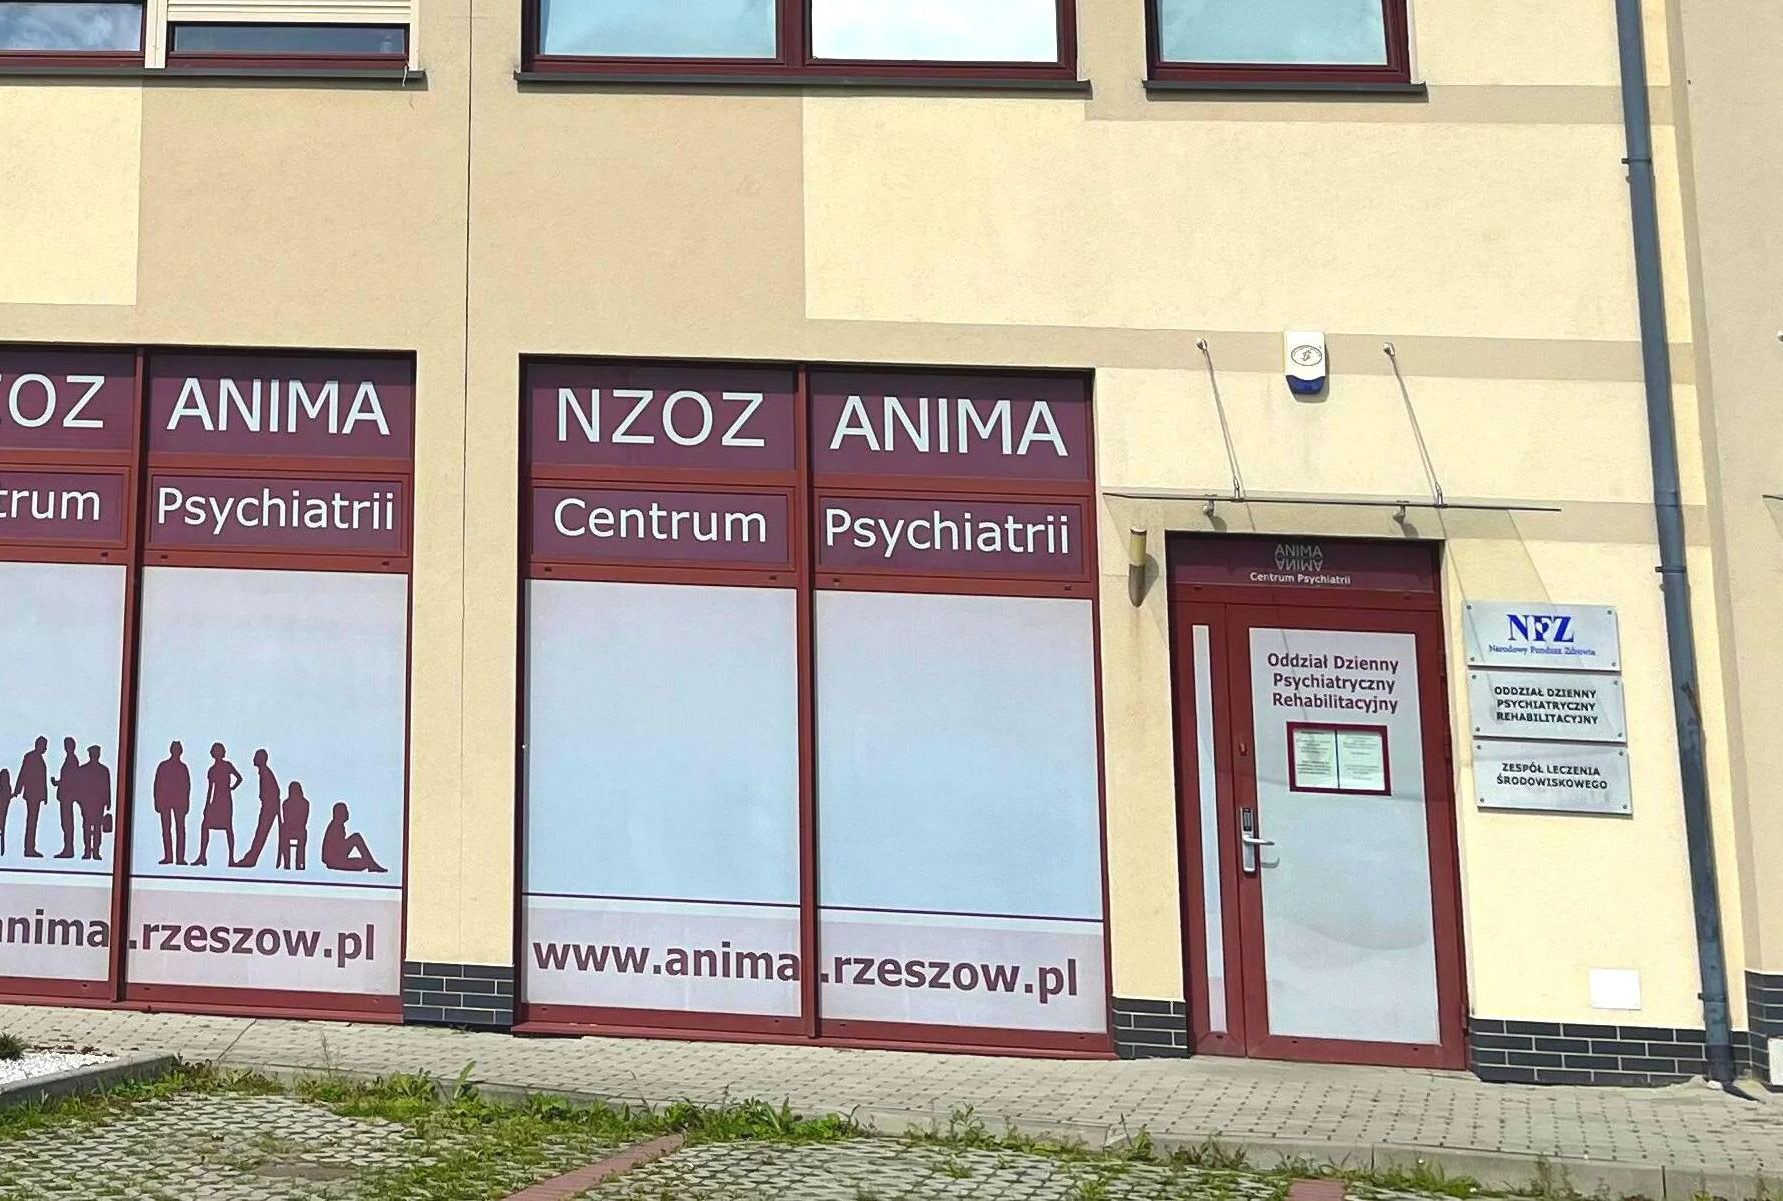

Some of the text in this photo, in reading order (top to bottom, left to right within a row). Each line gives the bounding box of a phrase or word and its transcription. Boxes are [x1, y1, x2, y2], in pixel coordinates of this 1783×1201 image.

[166, 376, 391, 436] ANIMA
[557, 387, 1069, 457] NZOZ ANIMA
[158, 487, 394, 535] Psychiatrii
[554, 497, 1069, 558] Centrum Psychiatrii
[1274, 543, 1323, 557] ANIMA
[1249, 572, 1351, 585] Centrum Psychiatrii
[1506, 614, 1574, 643] NFZ
[1488, 644, 1528, 655] Narodowy
[1267, 652, 1399, 675] Oddział Dzienny
[1273, 672, 1395, 694] Psychiatryczny
[1494, 686, 1596, 699] ODDZIAŁ DZIENNY
[1272, 692, 1398, 714] Rehabilitacyjny
[1496, 699, 1596, 711] PSYCHIATRYCZNY
[1496, 711, 1598, 725] REHABILITACYJNY
[1502, 762, 1601, 776] ZESPÓŁ LECZENIA
[1496, 773, 1608, 789] ŚRODOWISKOWEGO
